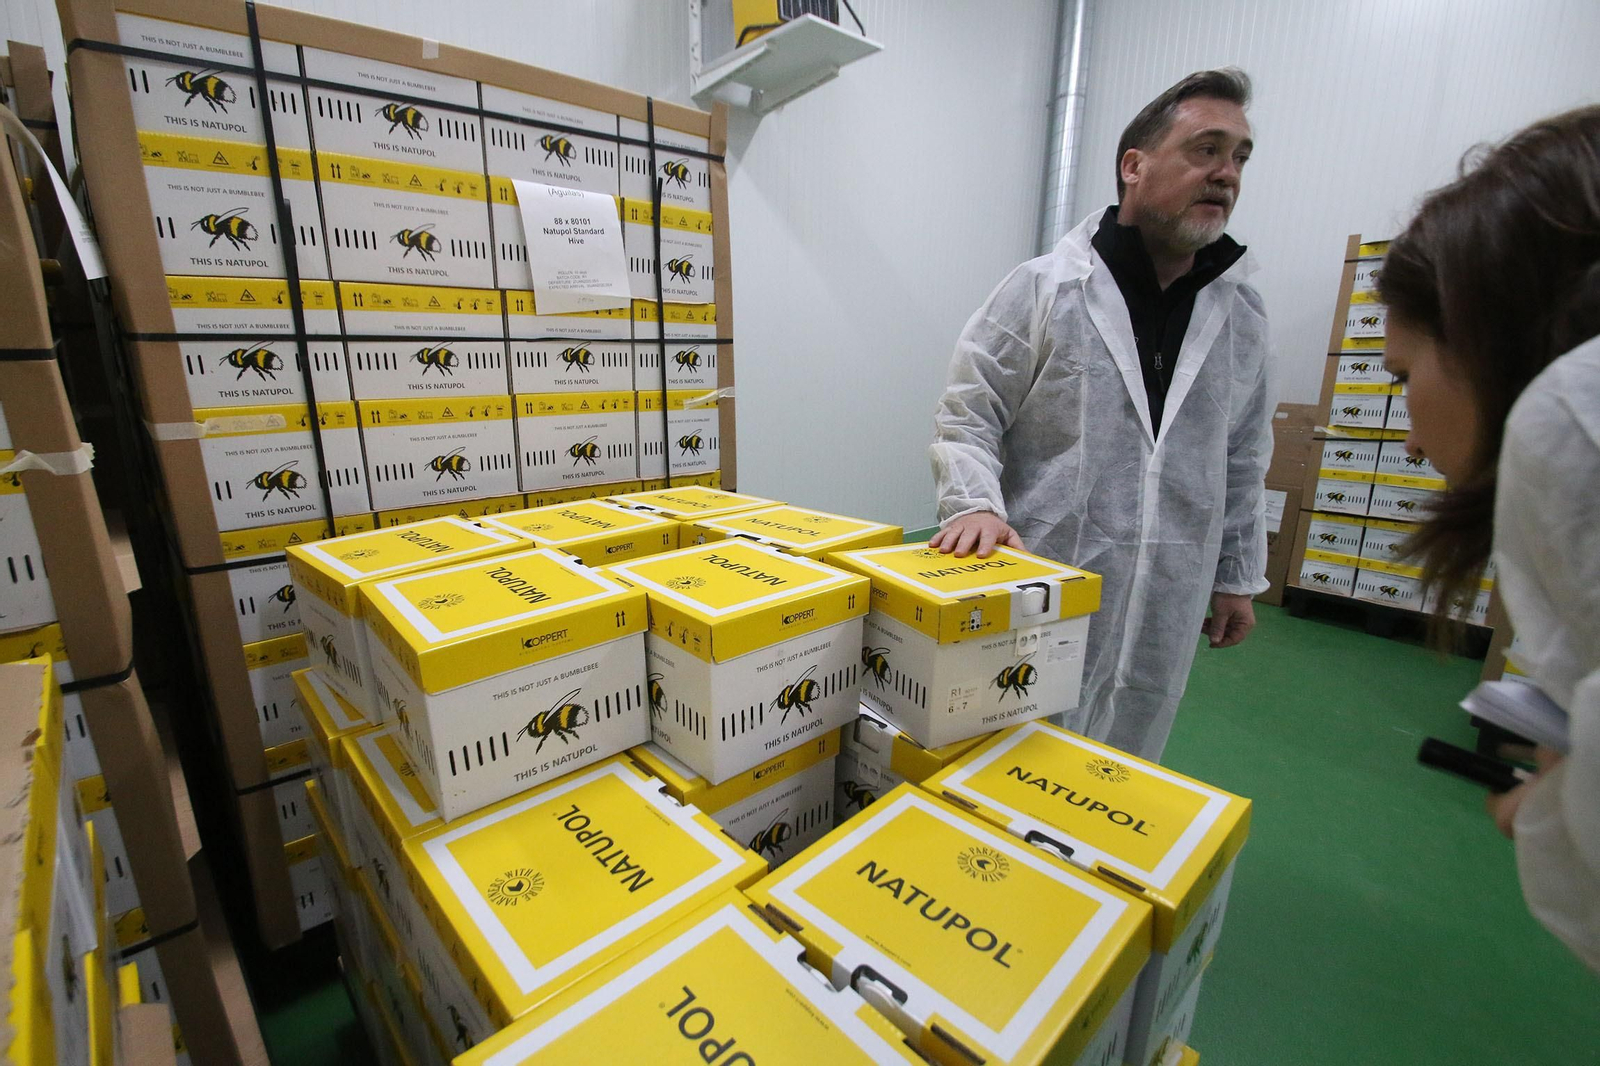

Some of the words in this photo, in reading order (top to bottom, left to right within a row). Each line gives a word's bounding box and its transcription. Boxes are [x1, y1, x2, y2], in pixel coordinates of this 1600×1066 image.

[141, 34, 156, 43] THIS
[165, 39, 180, 47] NOT
[205, 46, 243, 58] BUMBLEBEE
[165, 115, 187, 125] THIS
[189, 118, 199, 127] IS
[201, 120, 248, 133] NATUPOL
[373, 141, 390, 150] THIS
[401, 145, 436, 157] NATUPOL
[532, 168, 545, 176] THIS
[553, 172, 582, 183] NATUPOL
[228, 188, 264, 197] BUMBLEBEE
[543, 228, 572, 237] Natupol
[190, 257, 212, 265] THIS
[225, 258, 269, 267] NATUPOL
[414, 268, 449, 276] NATUPOL
[252, 387, 294, 396] NATUPOL
[446, 485, 477, 493] NATUPOL
[246, 510, 265, 518] THIS
[276, 504, 317, 514] NATUPOL
[559, 510, 616, 528] NATUPOL
[746, 518, 820, 536] NATUPOL
[397, 531, 454, 552] NATUPOL
[605, 542, 633, 554] KOPPERT
[703, 554, 787, 586] NATUPOL
[917, 559, 1018, 579] NATUPOL
[487, 567, 551, 604] NATUPOL
[268, 622, 286, 630] THIS
[782, 608, 815, 625] KOPPERT
[522, 629, 568, 649] KOPPERT
[756, 663, 768, 673] THIS
[774, 657, 786, 666] NOT
[786, 653, 798, 662] JUST
[803, 640, 830, 656] BUMBLEBEE
[492, 690, 509, 700] THIS
[518, 682, 534, 692] NOT
[536, 676, 551, 687] JUST
[559, 661, 598, 679] BUMBLEBEE
[869, 692, 894, 714] NATUPOL
[982, 713, 997, 724] THIS
[998, 711, 1005, 720] IS
[1006, 703, 1038, 717] NATUPOL
[764, 736, 781, 750] THIS
[782, 732, 789, 742] IS
[791, 718, 823, 738] NATUPOL
[514, 766, 537, 782] THIS
[540, 761, 549, 772] IS
[552, 744, 597, 767] NATUPOL
[753, 760, 786, 781] KOPPERT
[1006, 766, 1148, 836] NATUPOL
[557, 805, 654, 893] NATUPOL
[856, 860, 1011, 968] NATUPOL
